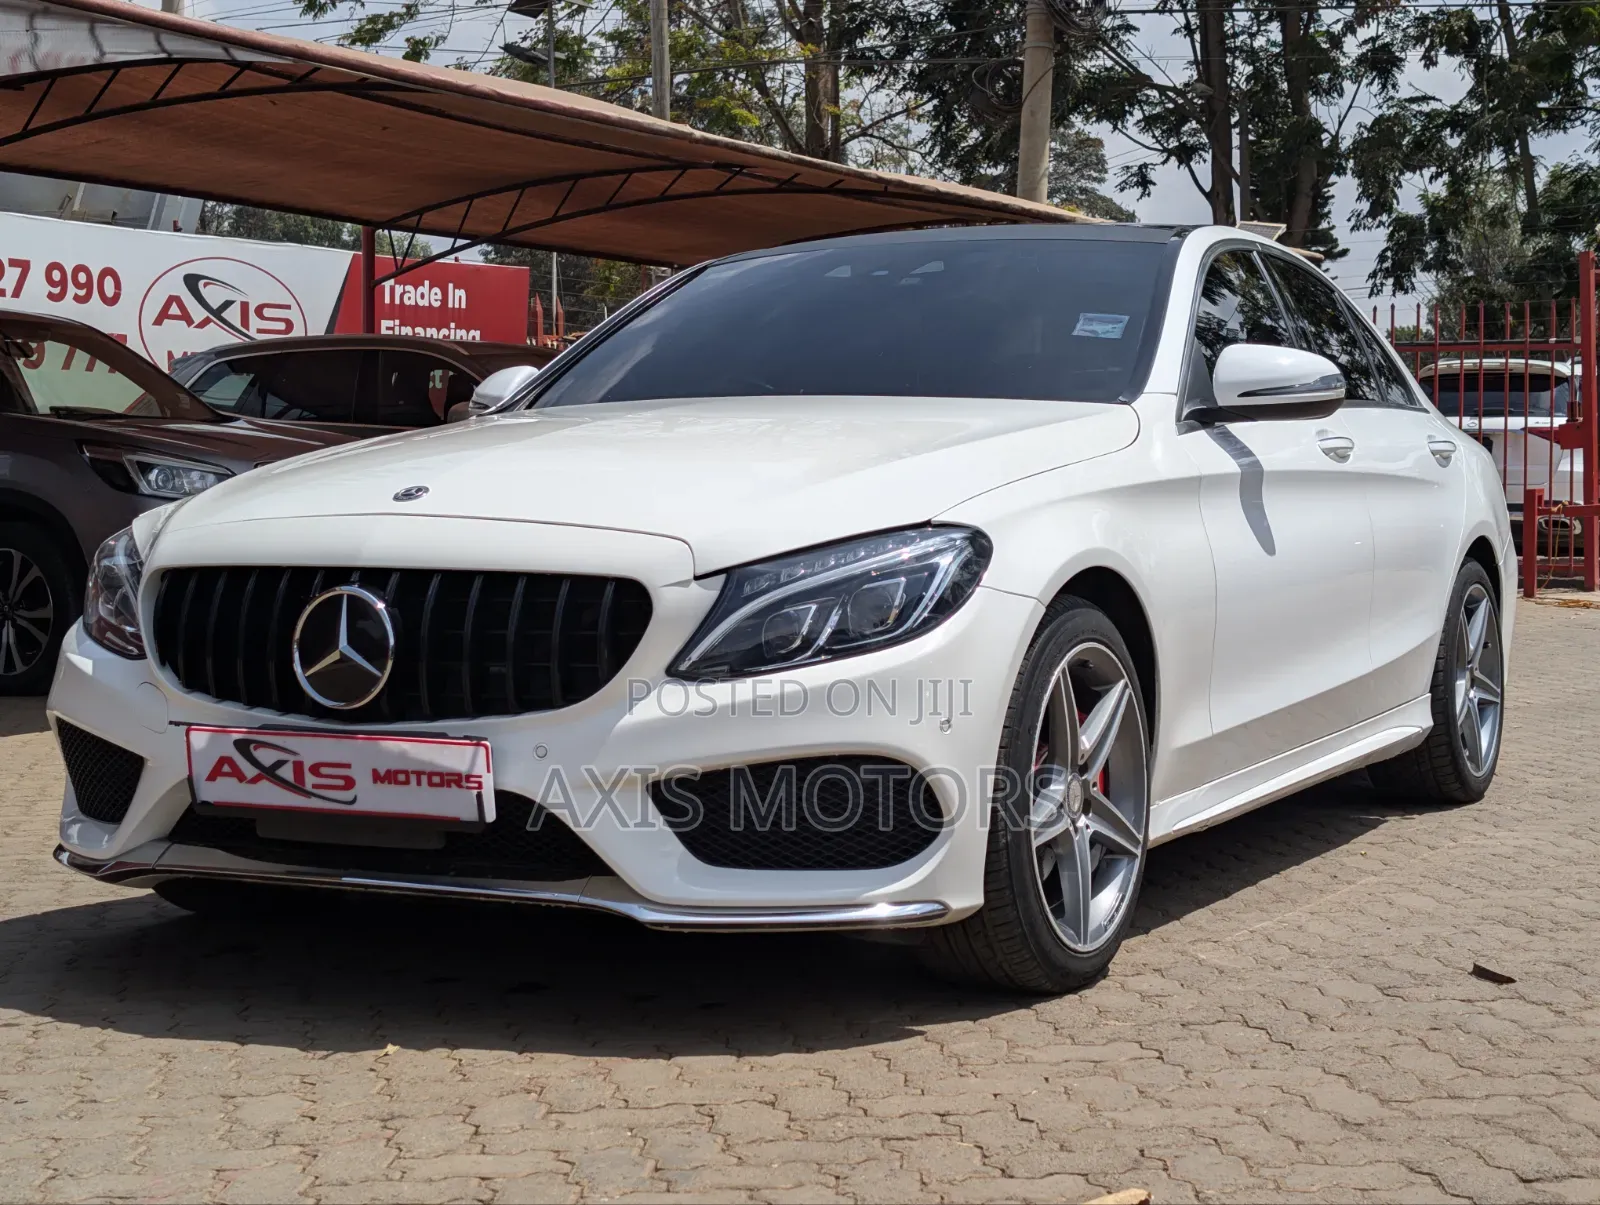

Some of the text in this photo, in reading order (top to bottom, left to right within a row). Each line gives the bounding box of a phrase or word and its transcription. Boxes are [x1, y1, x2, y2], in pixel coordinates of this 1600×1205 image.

[44, 261, 122, 307] 990
[151, 276, 295, 339] AXIS
[381, 278, 467, 309] Trade In
[205, 741, 483, 802] AXIS MOTORS
